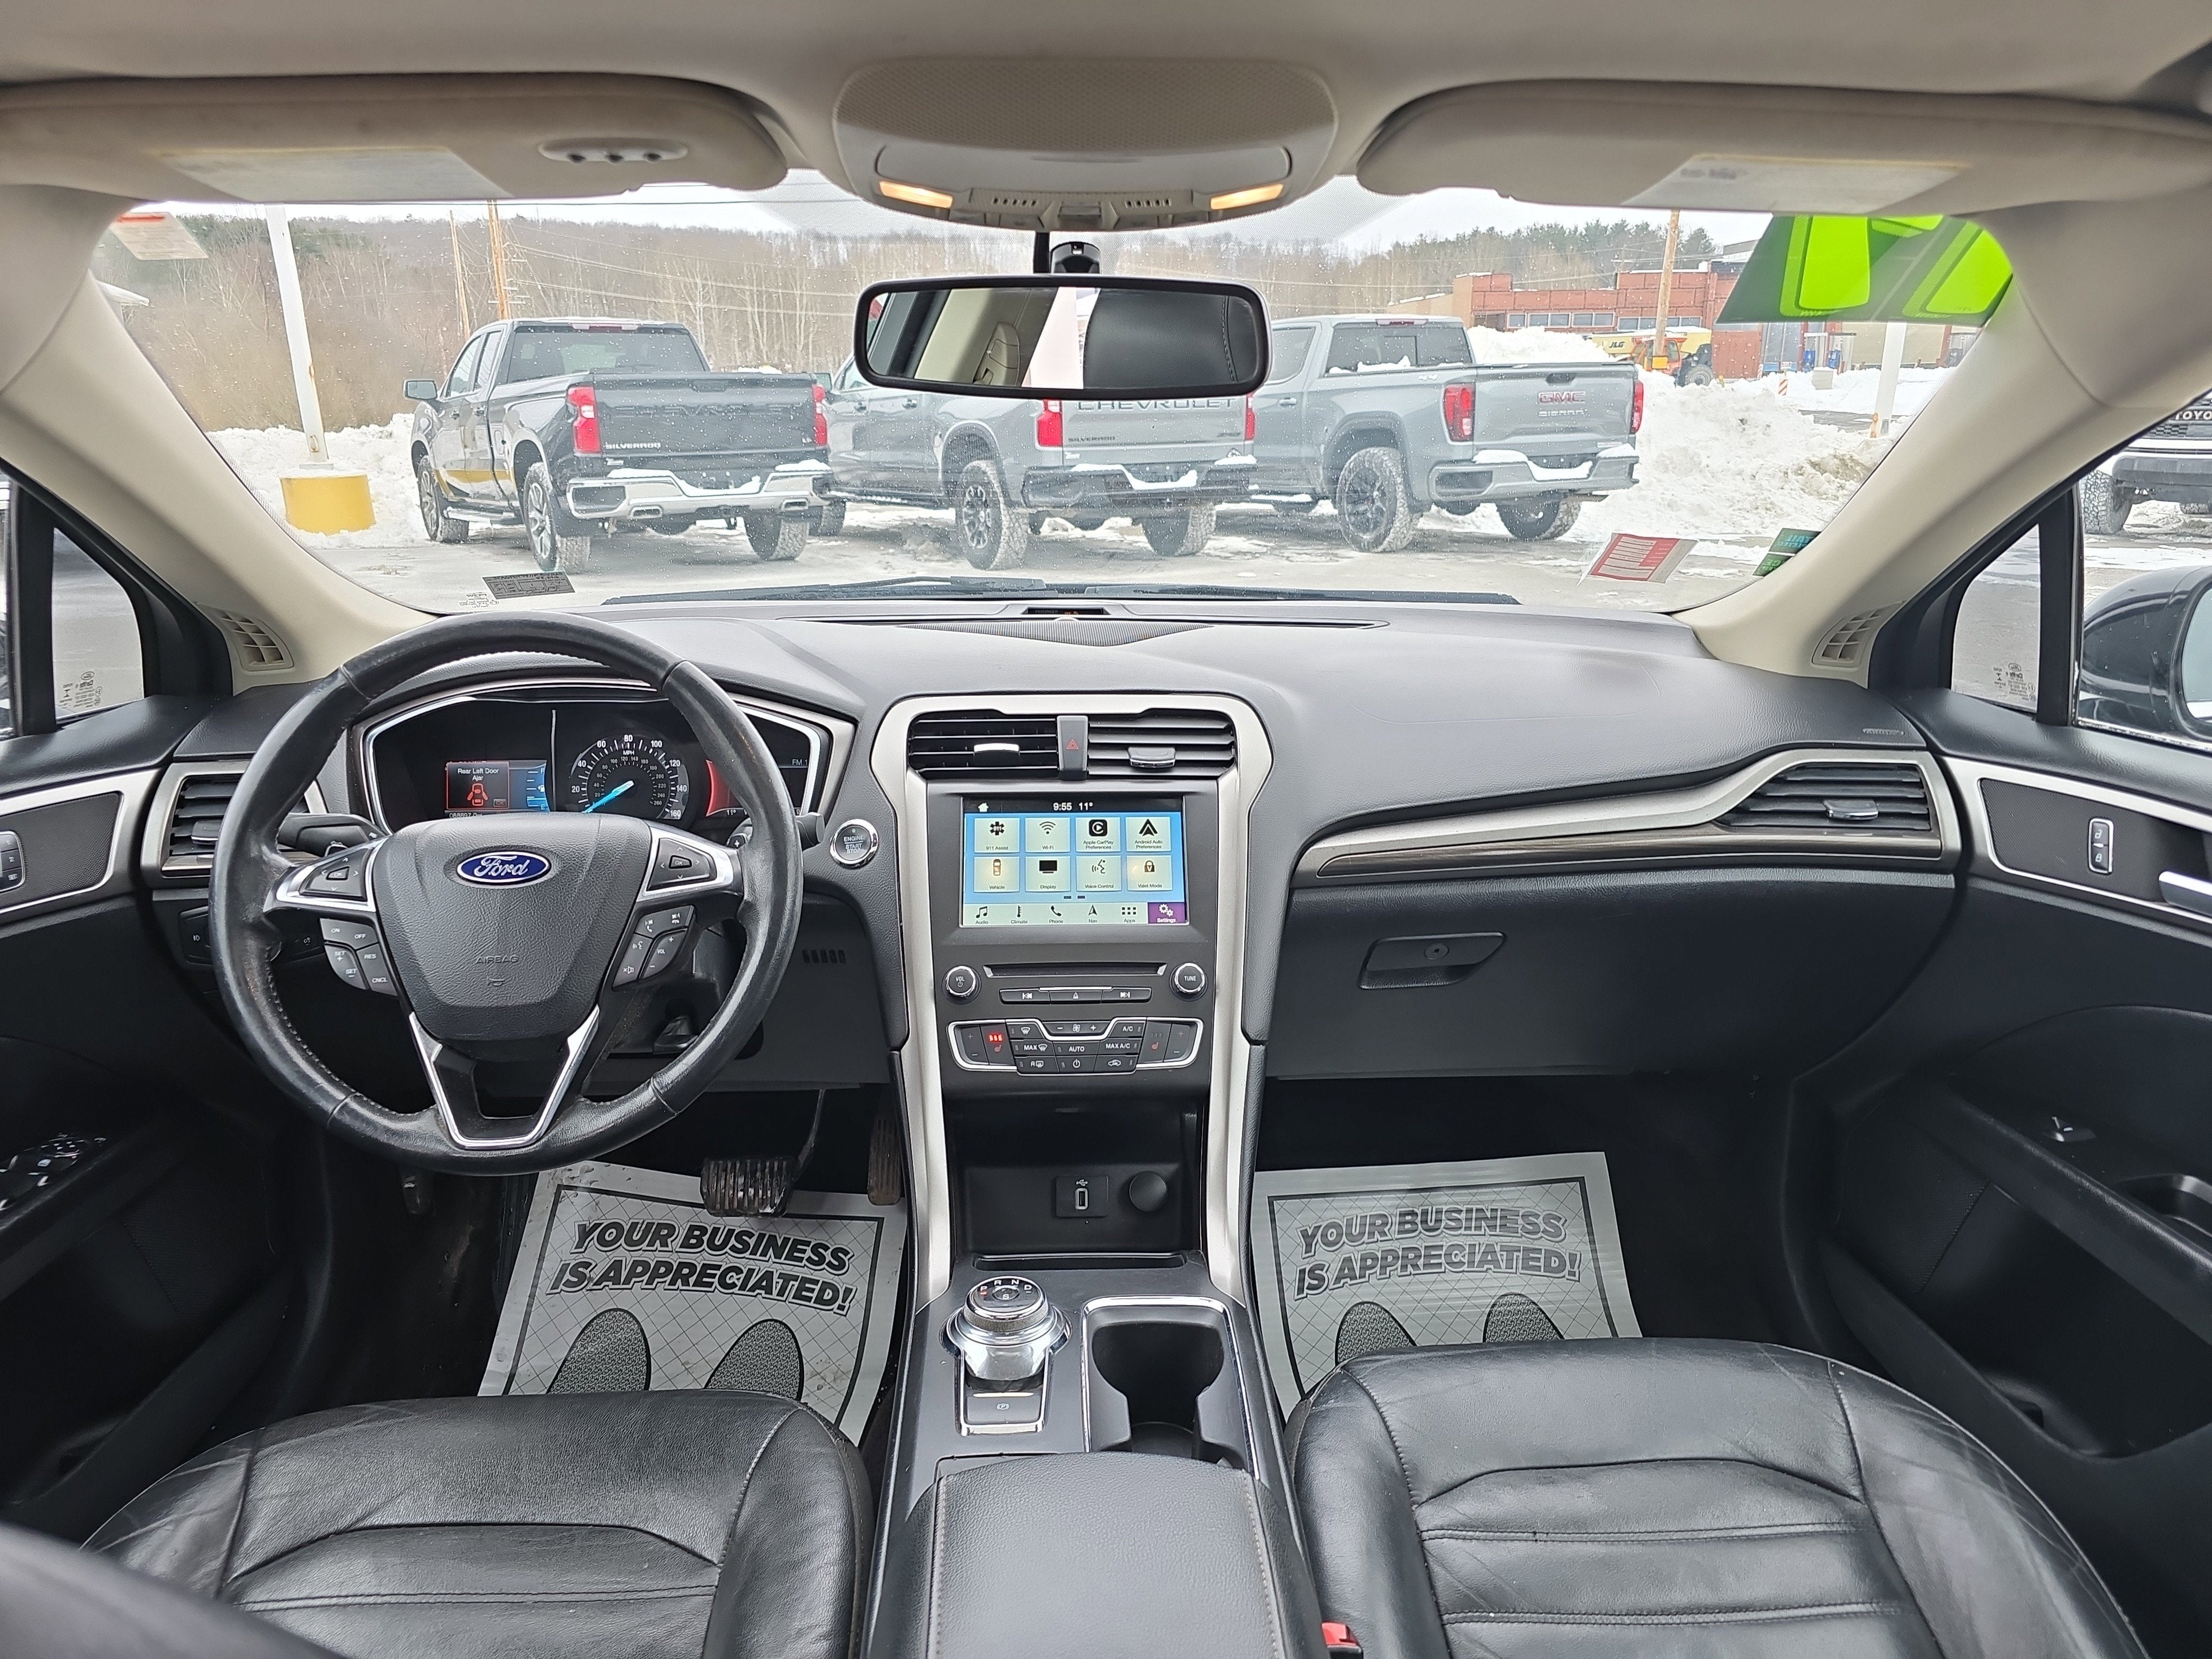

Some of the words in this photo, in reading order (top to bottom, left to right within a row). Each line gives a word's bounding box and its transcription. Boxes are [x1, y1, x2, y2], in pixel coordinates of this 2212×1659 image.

[1078, 398, 1235, 411] CHEVROLET
[1538, 391, 1586, 404] GMC
[670, 809, 681, 818] 160
[1053, 802, 1072, 811] 9:55
[474, 855, 530, 877] Ford
[475, 956, 519, 964] AIRBAG
[1298, 1210, 1394, 1259] YOUR
[1394, 1205, 1568, 1243] BUSINESS
[571, 1219, 680, 1255] YOUR
[674, 1220, 858, 1277] BUSINESS
[1294, 1260, 1330, 1300] IS
[1330, 1242, 1581, 1291] APPRECIATED!
[545, 1258, 598, 1295] IS
[586, 1256, 858, 1312] APPRECIATED!
